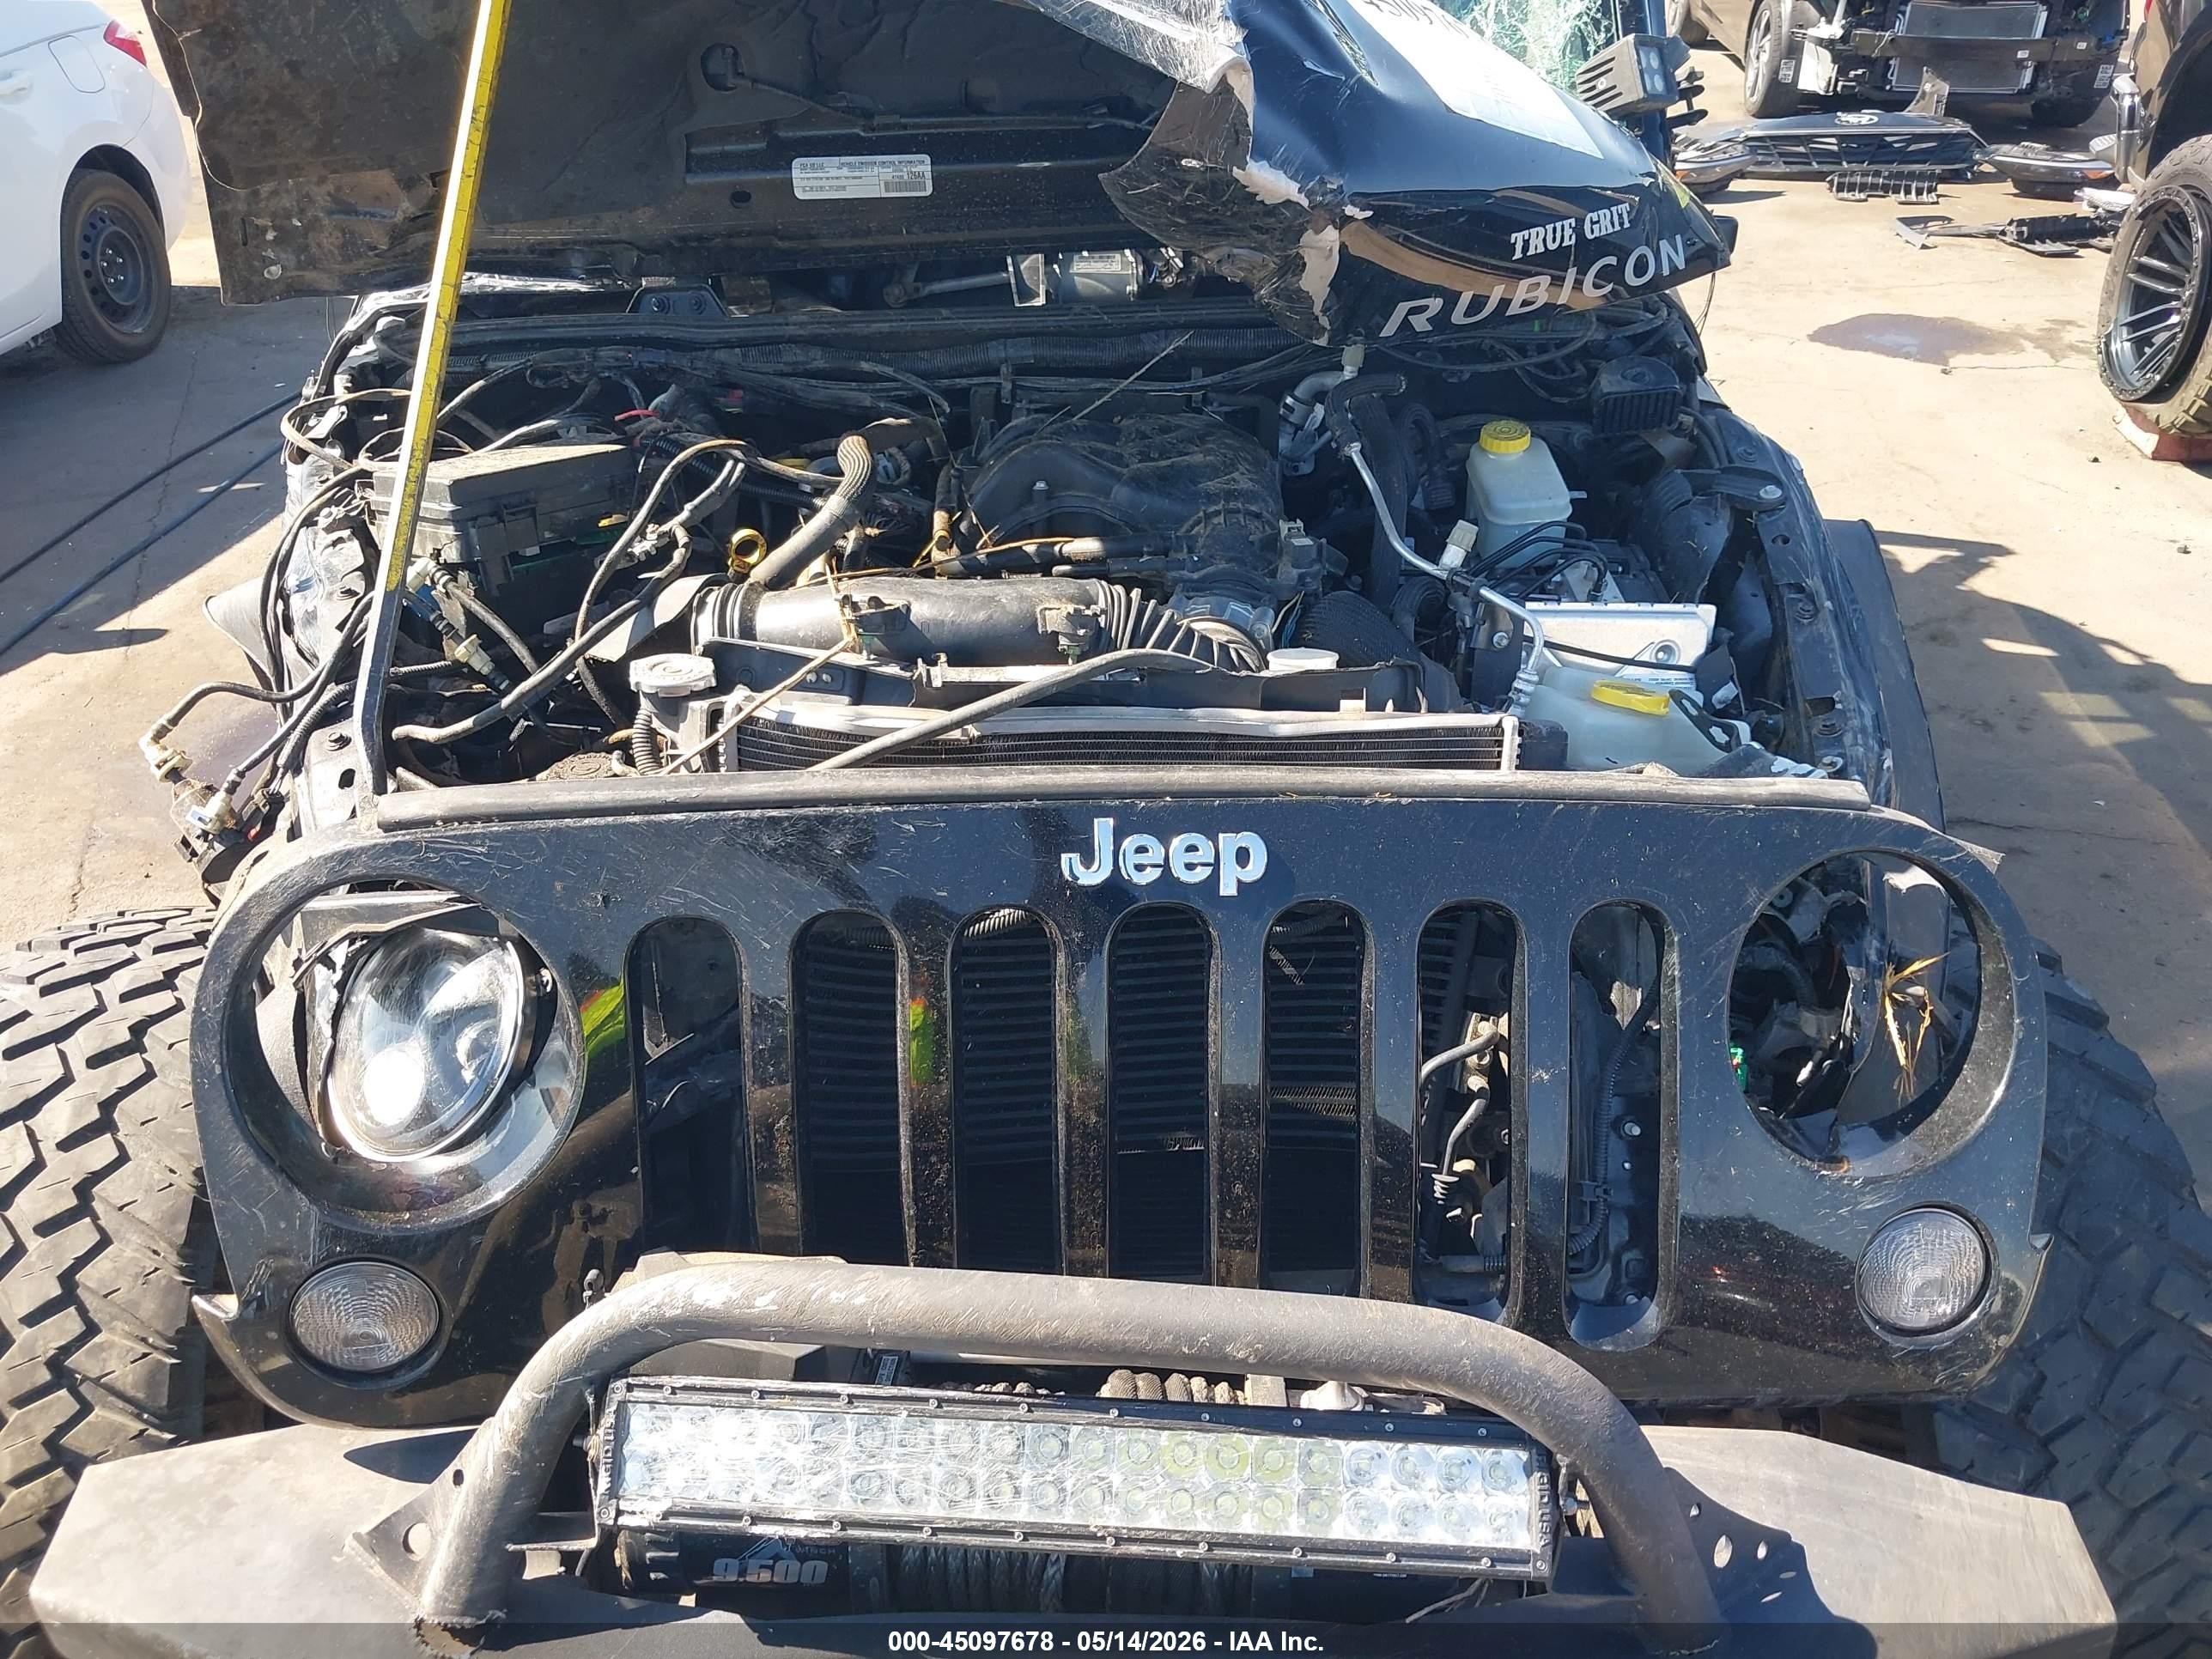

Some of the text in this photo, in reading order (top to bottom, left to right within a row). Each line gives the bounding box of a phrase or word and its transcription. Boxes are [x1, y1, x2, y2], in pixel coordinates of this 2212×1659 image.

[1510, 204, 1631, 260] TRUE GRIT
[1379, 234, 1686, 337] RUBICON
[1060, 817, 1267, 896] Jeep
